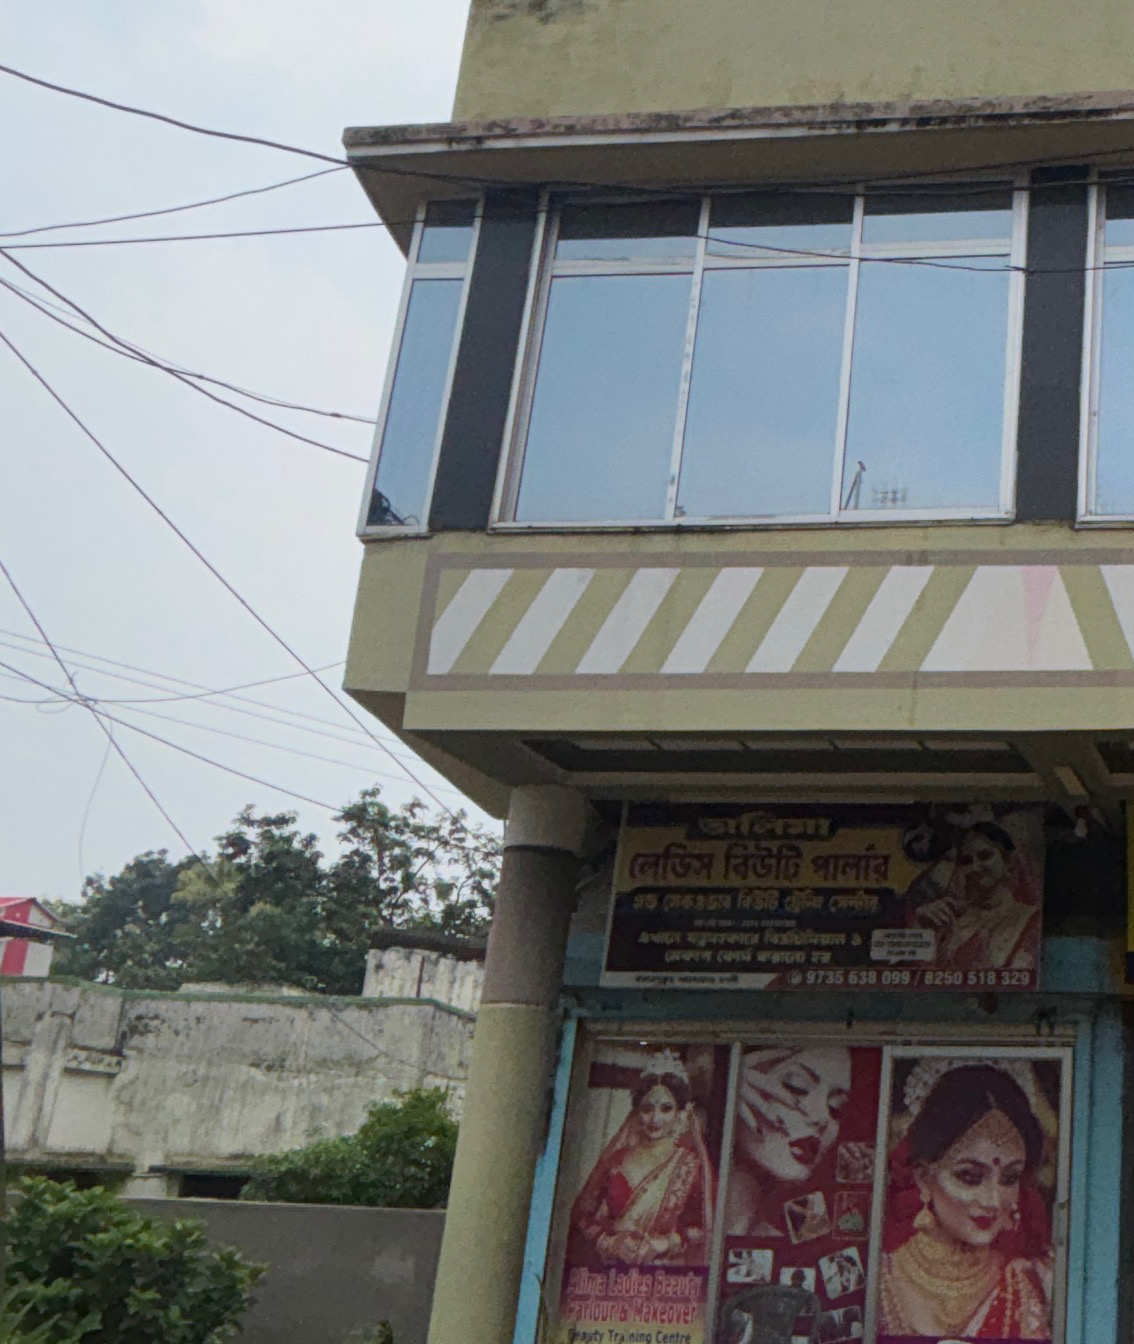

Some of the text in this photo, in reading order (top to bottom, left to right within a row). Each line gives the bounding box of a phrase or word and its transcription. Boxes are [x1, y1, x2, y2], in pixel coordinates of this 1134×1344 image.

[628, 842, 891, 881] লেডিস বিউটি পার্লার
[805, 970, 844, 984] 9735
[848, 971, 878, 985] 638
[882, 971, 911, 985] 099
[924, 971, 962, 986] 8250
[967, 972, 996, 986] 518
[1001, 972, 1030, 987] 329
[607, 1266, 653, 1297] Ladies
[631, 1301, 697, 1324] Makeover
[655, 1331, 691, 1344] Centre
